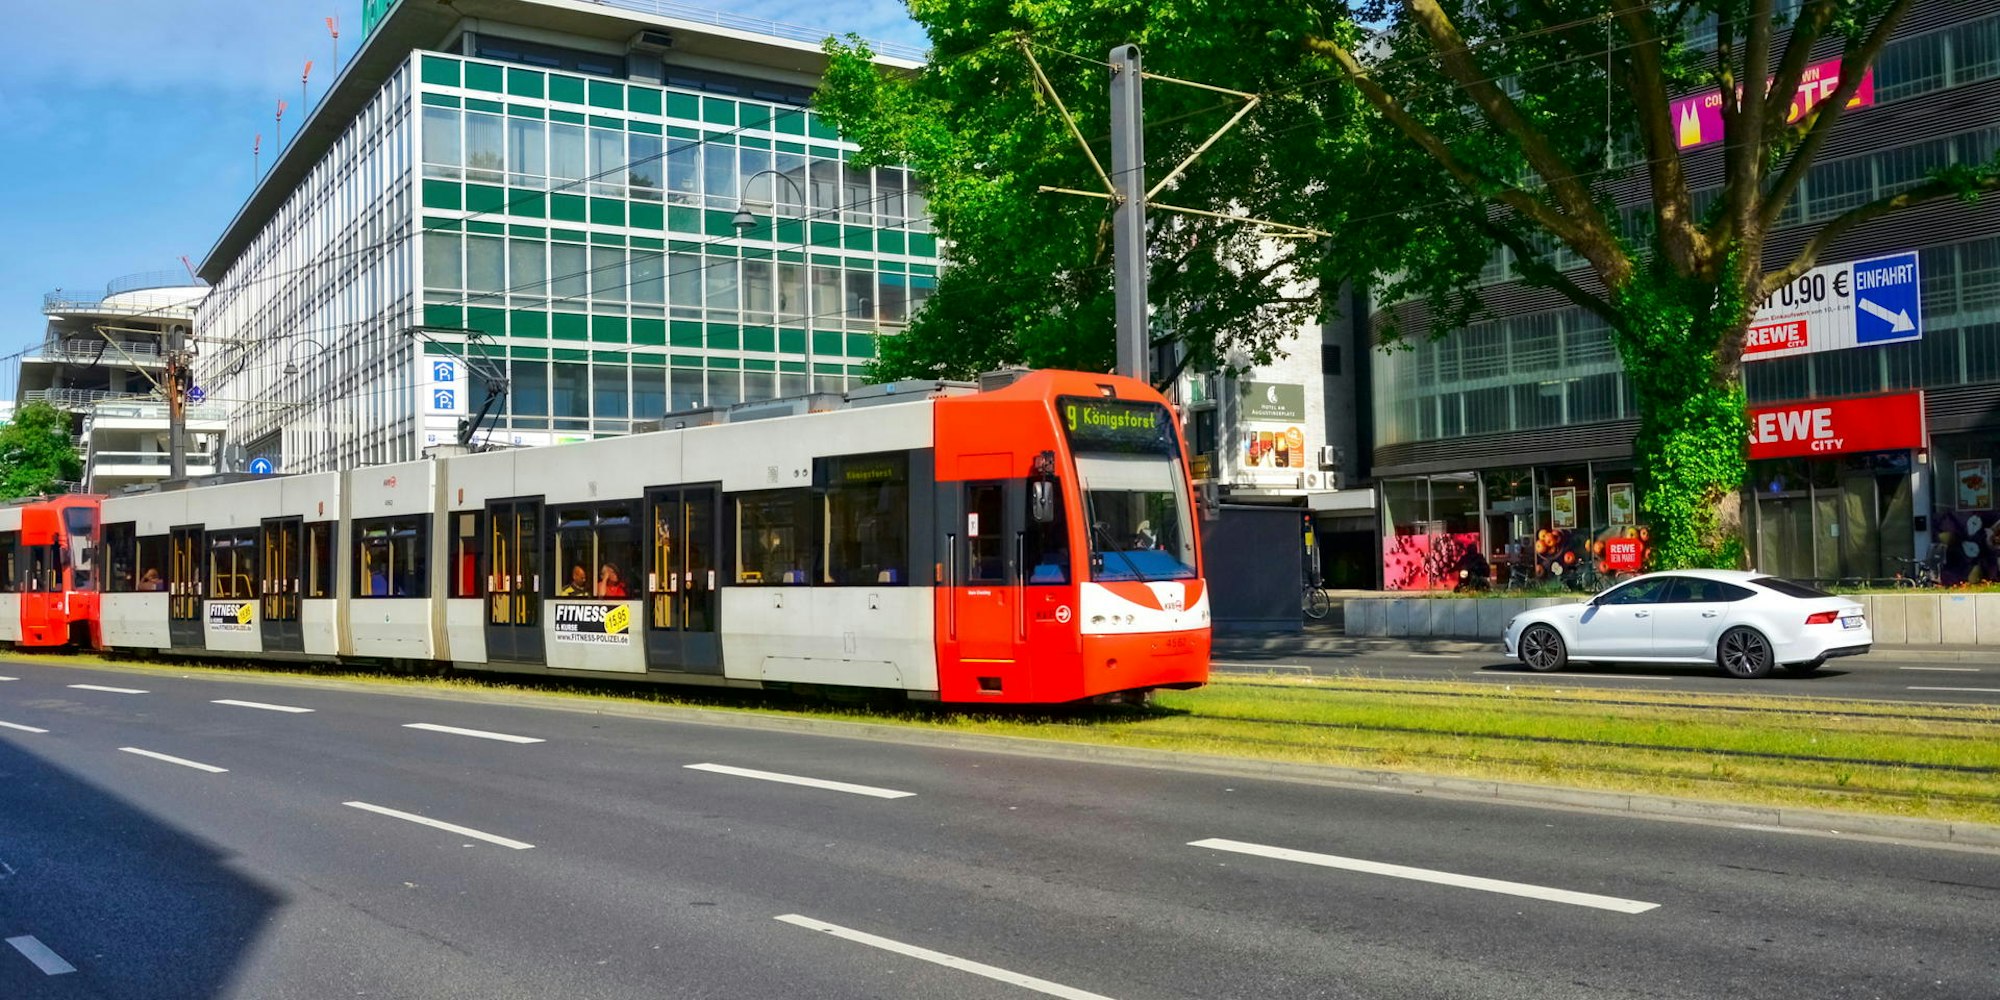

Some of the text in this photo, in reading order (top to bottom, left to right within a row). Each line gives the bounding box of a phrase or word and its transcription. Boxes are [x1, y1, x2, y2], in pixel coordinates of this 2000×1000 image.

[1856, 263, 1914, 290] EINFAHRT
[1781, 273, 1826, 310] 0,90
[1832, 270, 1850, 298] €
[1747, 323, 1800, 347] REWE
[1787, 339, 1806, 348] CITY
[1067, 405, 1156, 432] 9 Königsforst
[1810, 438, 1844, 451] CITY
[1610, 543, 1636, 554] REWE
[211, 604, 240, 616] FITNESS
[556, 605, 608, 623] FITNESS
[556, 623, 578, 632] & KURSE
[557, 633, 629, 644] www.FITNESS-POLIZEI.de
